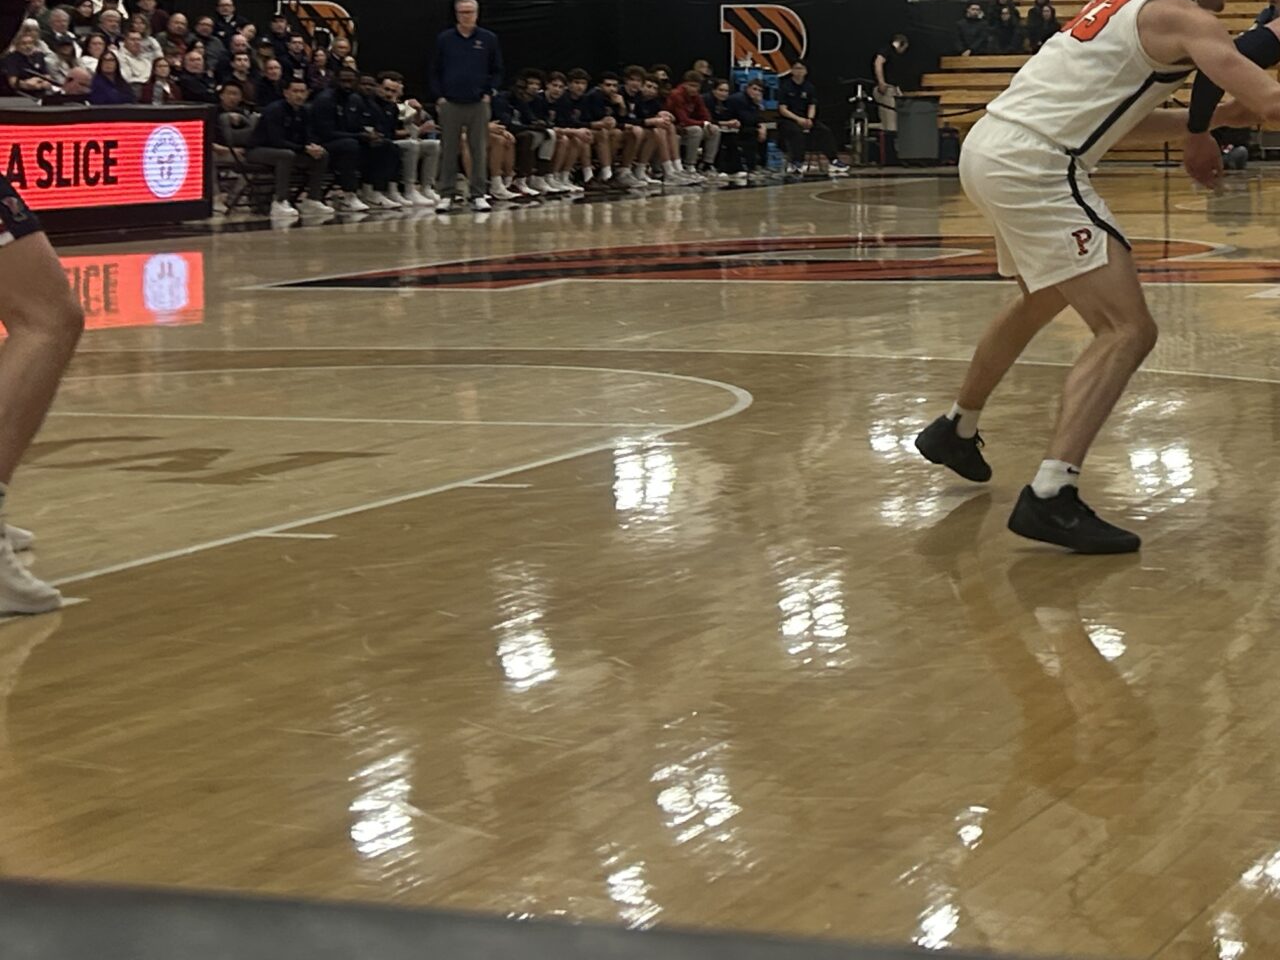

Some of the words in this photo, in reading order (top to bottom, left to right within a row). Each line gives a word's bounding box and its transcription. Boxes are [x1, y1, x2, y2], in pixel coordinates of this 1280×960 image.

[6, 142, 28, 190] A
[35, 139, 119, 189] SLICE
[1071, 227, 1092, 256] P
